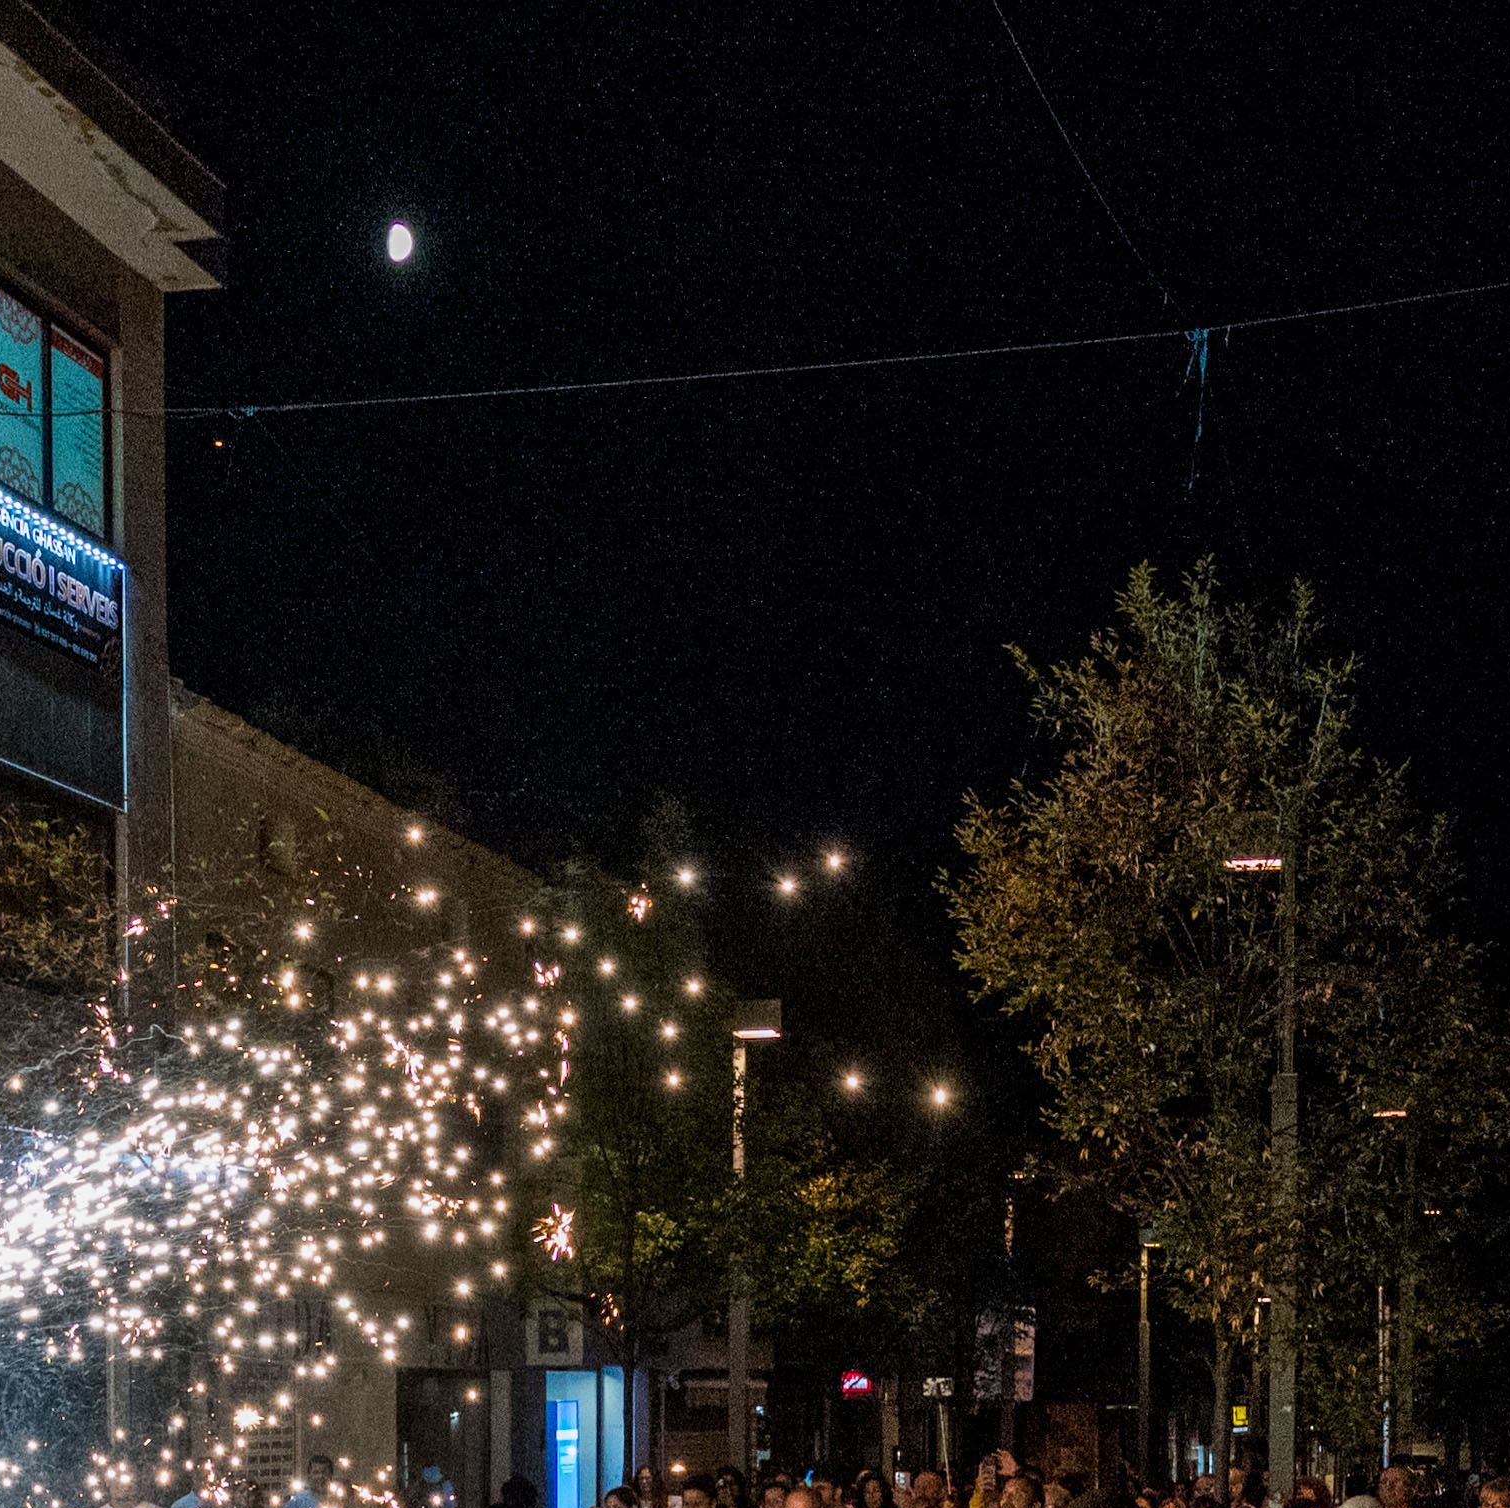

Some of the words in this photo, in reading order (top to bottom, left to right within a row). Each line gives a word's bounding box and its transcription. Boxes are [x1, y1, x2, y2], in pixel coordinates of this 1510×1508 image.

[32, 528, 77, 565] GHASSAN
[49, 566, 55, 596] I
[57, 571, 118, 630] SERVEIS
